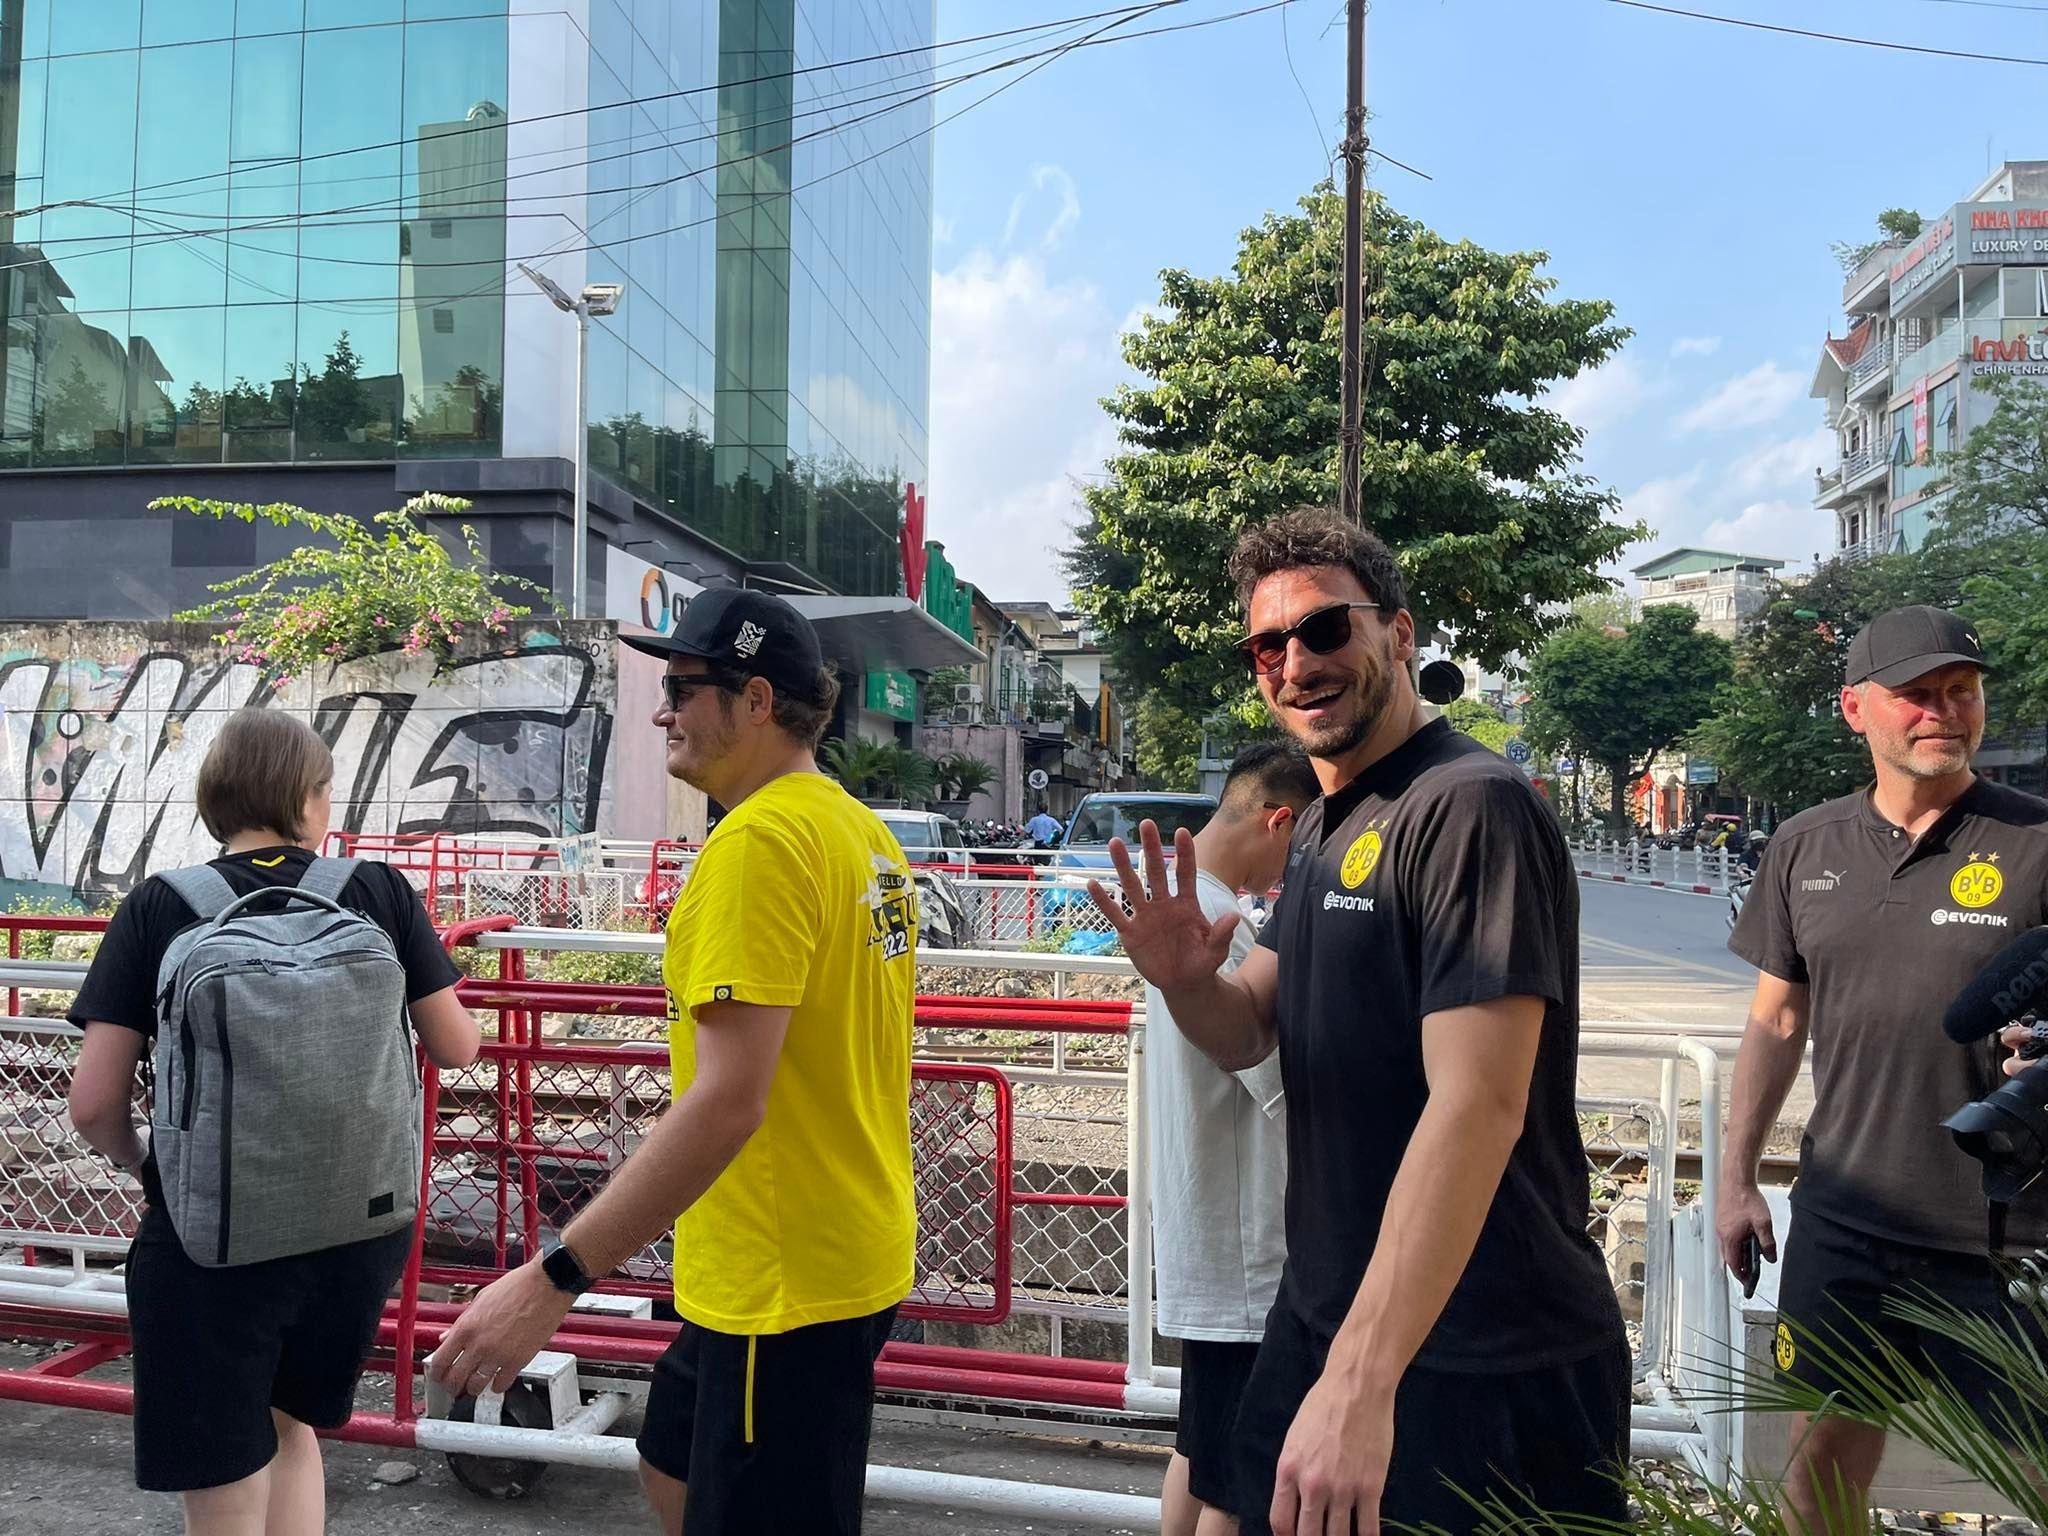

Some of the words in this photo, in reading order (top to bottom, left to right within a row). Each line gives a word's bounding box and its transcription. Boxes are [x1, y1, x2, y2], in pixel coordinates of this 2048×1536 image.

[1971, 210, 2012, 230] NHA
[1972, 240, 2028, 253] LUXURY
[1346, 838, 1377, 871] BVB
[1801, 879, 1834, 891] PUMA
[1957, 868, 1997, 893] BVB
[1332, 894, 1375, 912] EVONIK
[1966, 892, 1981, 903] 09
[1947, 911, 2009, 927] EVONIK
